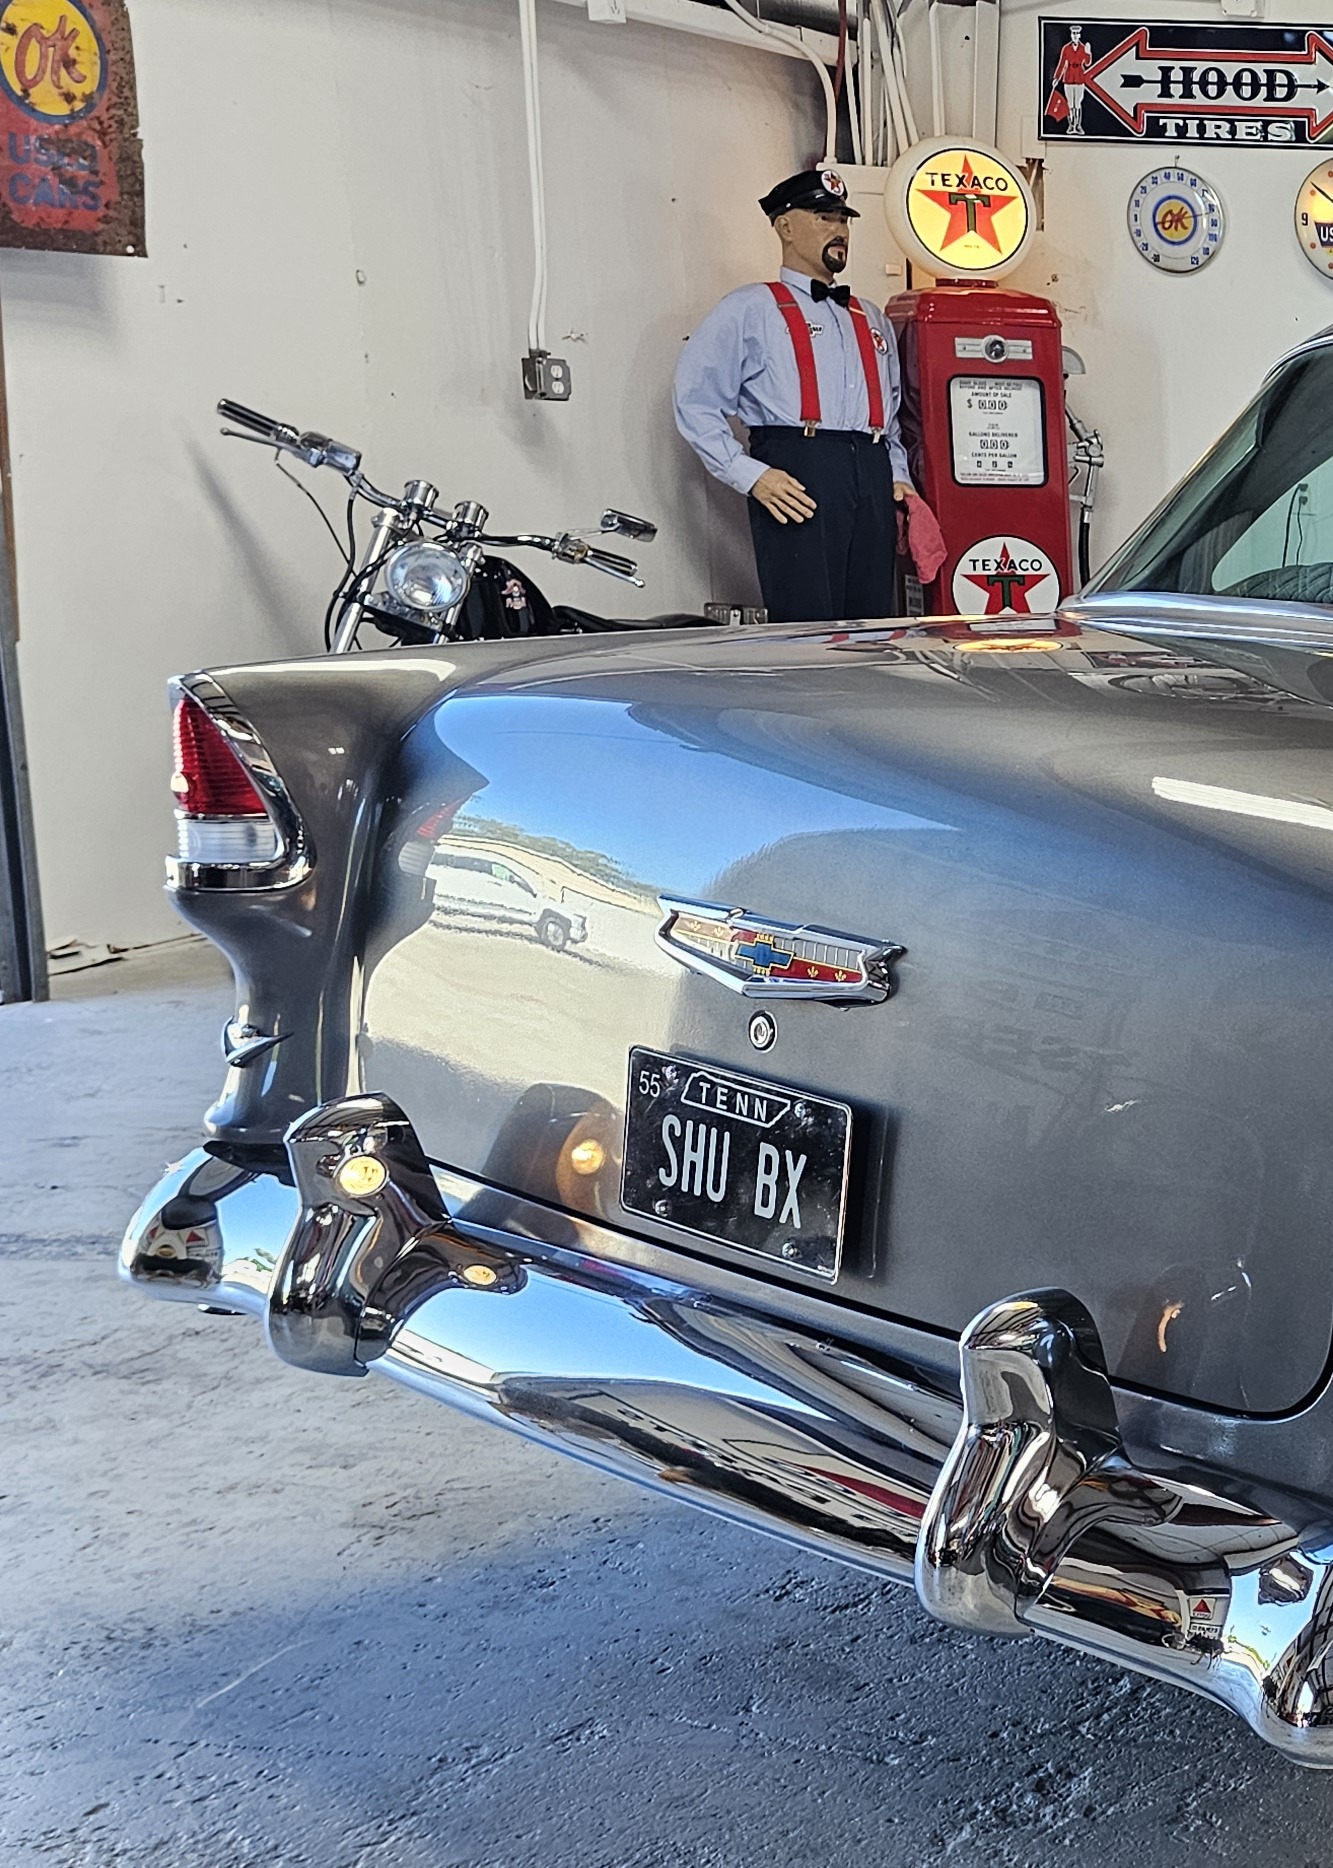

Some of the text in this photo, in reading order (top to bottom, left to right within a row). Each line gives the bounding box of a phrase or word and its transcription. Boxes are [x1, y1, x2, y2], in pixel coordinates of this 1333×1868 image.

[14, 14, 88, 89] OK
[1157, 65, 1299, 103] HOOD
[1159, 118, 1296, 142] TIRES
[8, 172, 101, 211] CARS
[925, 172, 1009, 192] TEXACO
[1160, 206, 1189, 232] OK
[1301, 212, 1309, 226] 9
[968, 558, 1043, 572] TEXACO
[638, 1070, 661, 1098] 55
[698, 1081, 769, 1122] TENN
[658, 1113, 808, 1230] SHU BX
